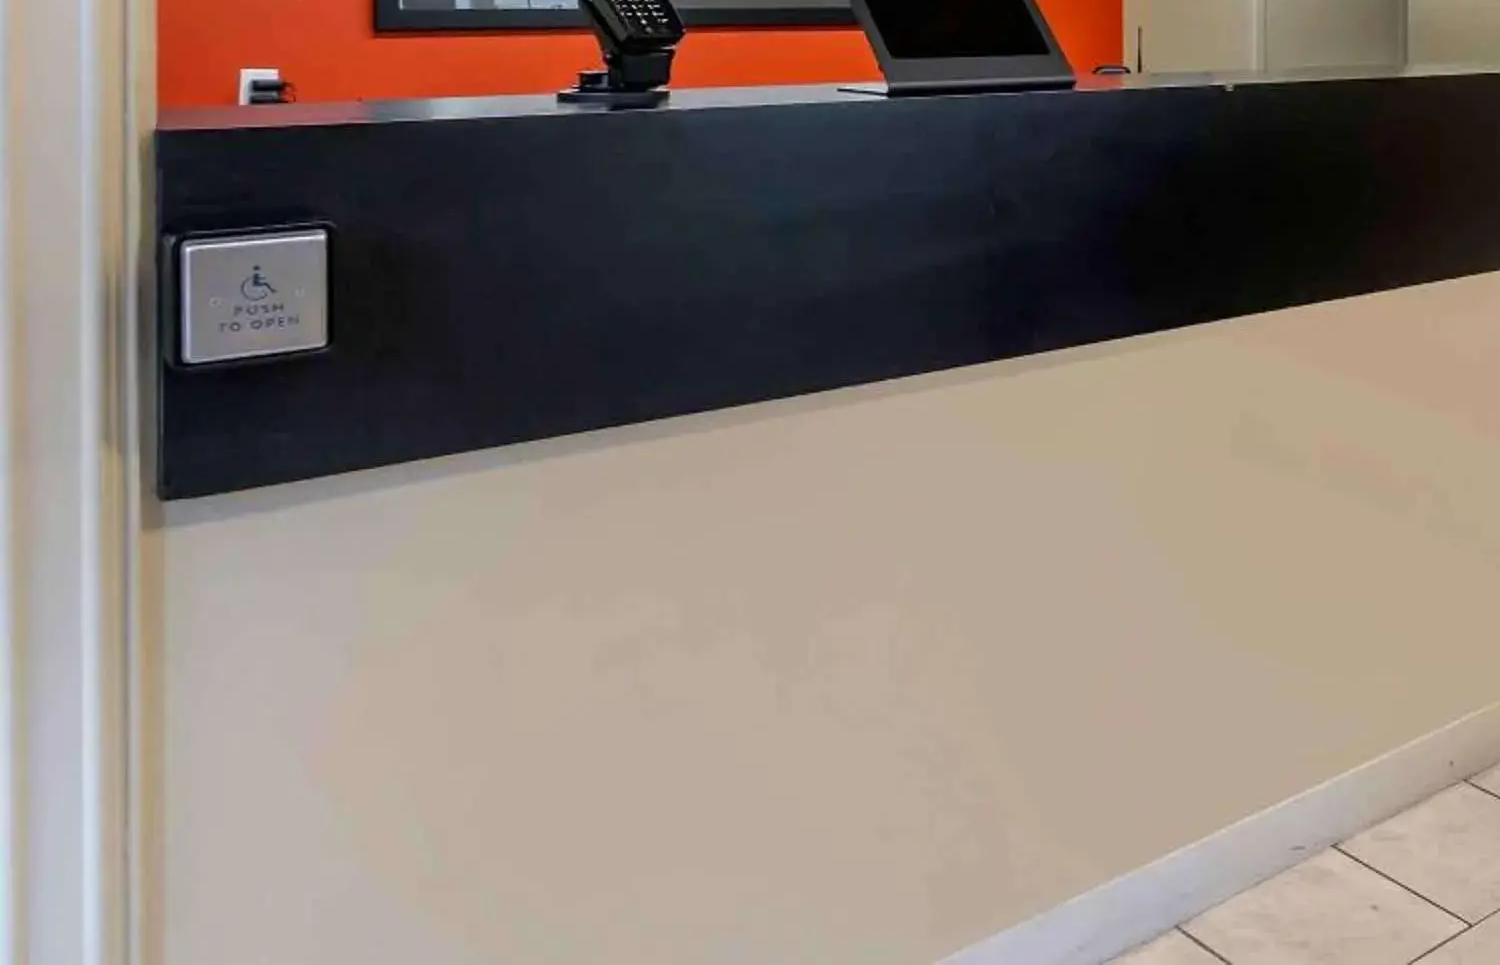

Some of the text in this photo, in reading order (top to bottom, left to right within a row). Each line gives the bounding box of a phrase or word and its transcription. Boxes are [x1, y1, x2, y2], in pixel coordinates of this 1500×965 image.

[234, 303, 284, 316] PUSH
[218, 315, 299, 333] TO OPEN
